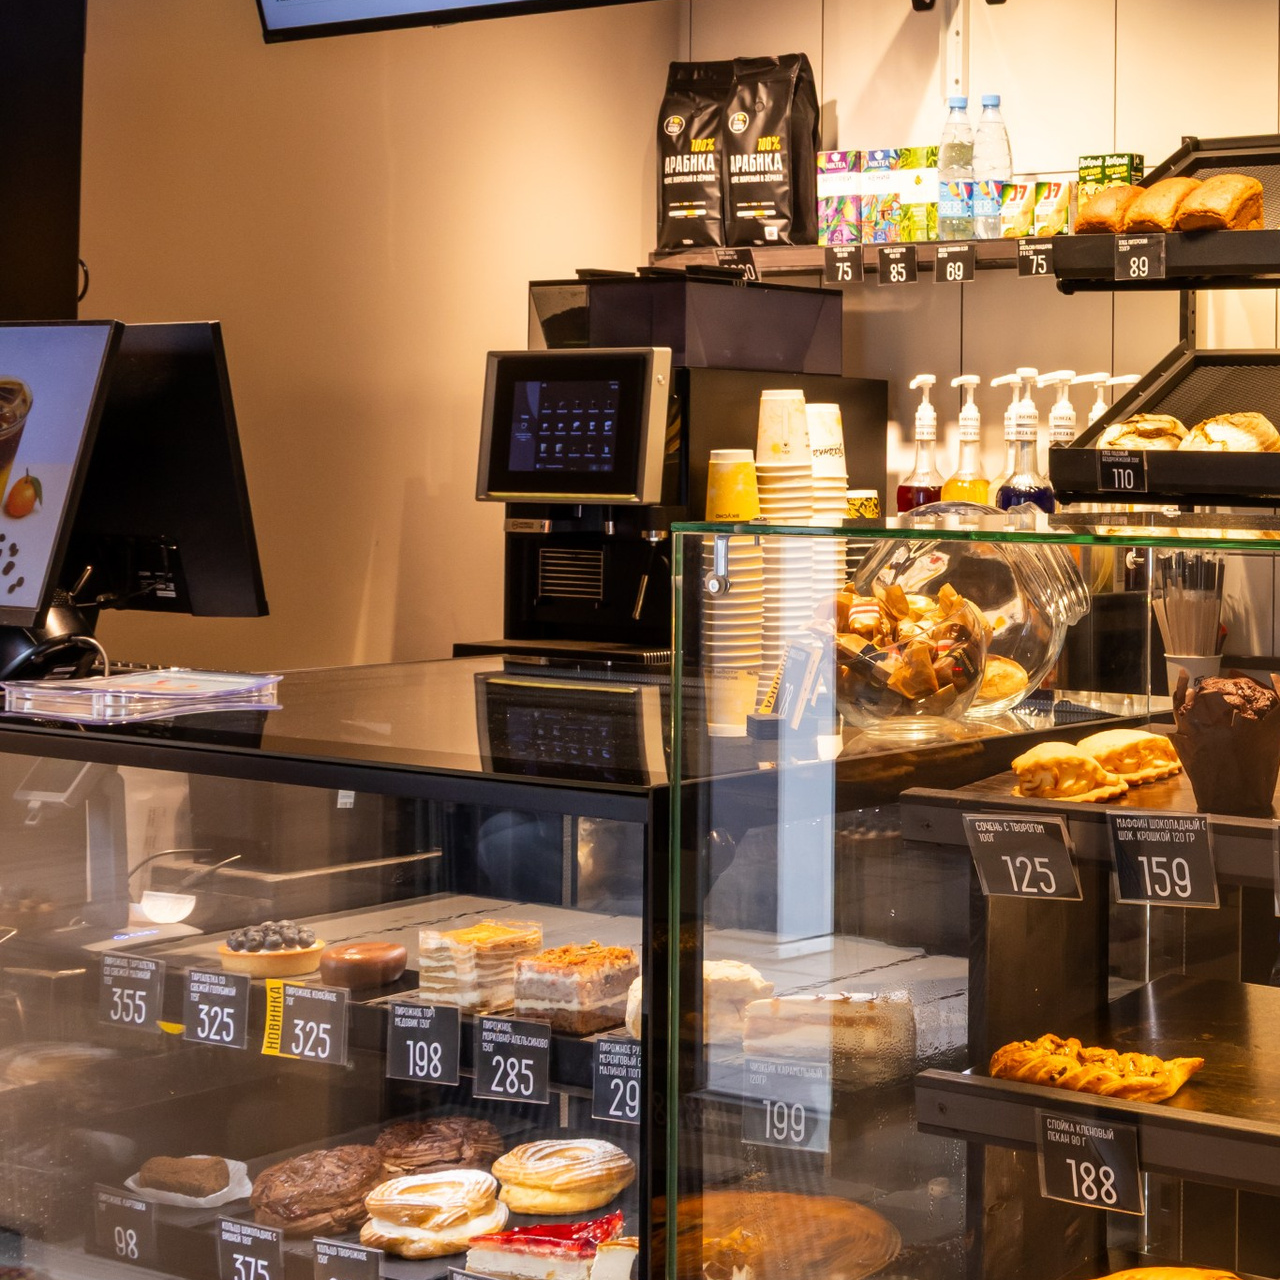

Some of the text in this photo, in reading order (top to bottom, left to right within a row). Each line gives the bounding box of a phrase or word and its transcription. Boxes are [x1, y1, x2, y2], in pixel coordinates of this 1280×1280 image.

[691, 137, 715, 152] 100%
[758, 136, 781, 151] 100%
[665, 152, 715, 174] АРАБИКА
[730, 152, 783, 173] АРАБИКА
[825, 161, 846, 170] NIKTEA
[868, 159, 890, 168] NIKTEA
[836, 263, 852, 281] 75
[890, 264, 906, 282] 85
[946, 261, 963, 281] 69
[1129, 256, 1149, 277] 89
[1112, 469, 1134, 489] 110
[1001, 855, 1056, 893] 125
[1138, 856, 1192, 898] 159
[111, 988, 146, 1023] 355
[197, 1004, 234, 1042] 325
[266, 986, 281, 1050] НОВИНКА
[292, 1019, 331, 1058] 325
[406, 1040, 442, 1078] 198
[491, 1055, 534, 1096] 285
[763, 1100, 805, 1142] 199
[1066, 1158, 1117, 1205] 188
